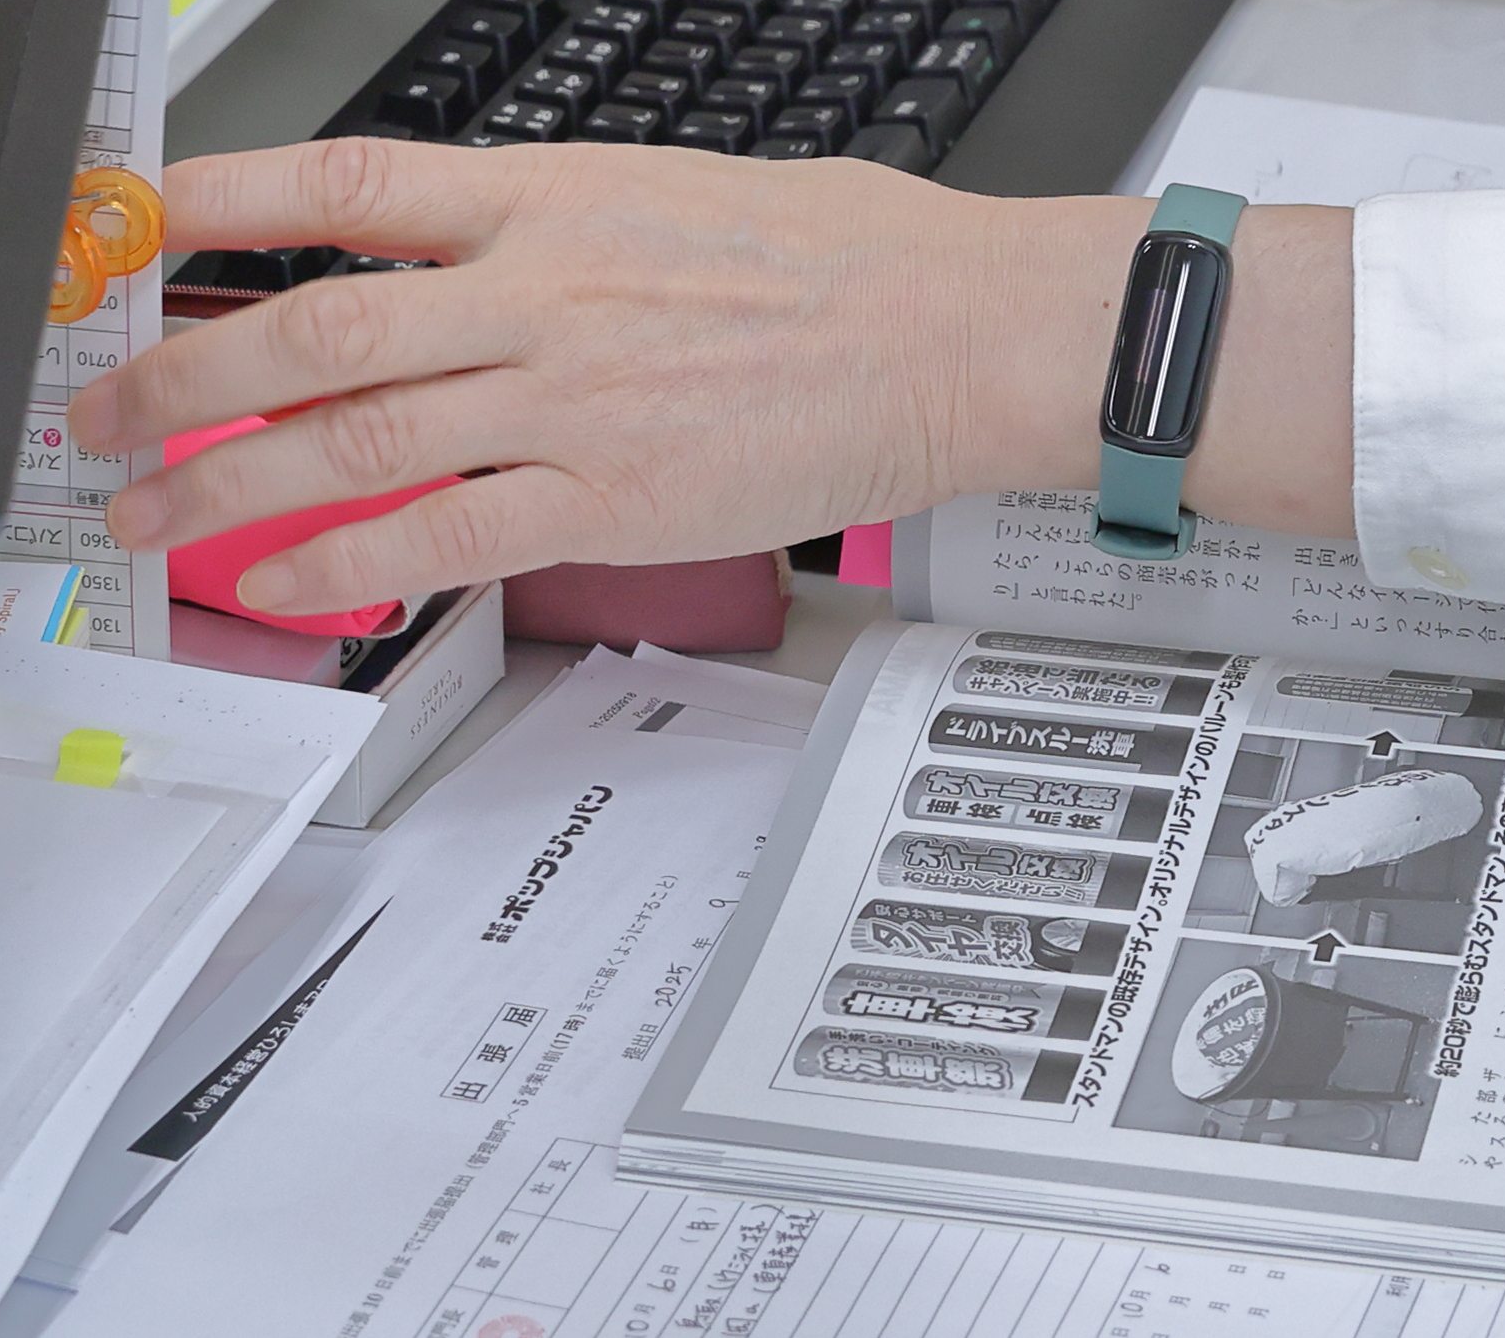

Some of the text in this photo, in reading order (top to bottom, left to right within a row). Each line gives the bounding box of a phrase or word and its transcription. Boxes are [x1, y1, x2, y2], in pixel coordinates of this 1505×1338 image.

[77, 351, 117, 369] 0710
[82, 574, 122, 591] 1350
[992, 552, 1261, 593] たら、こちらの商売あがった
[90, 618, 122, 633] 130
[420, 667, 457, 707] CARDS
[409, 677, 464, 741] BUSINESS
[943, 715, 1136, 759] ドライブスルー洗車
[925, 769, 1123, 811] オイル交換
[925, 797, 1007, 820] 車検
[499, 784, 615, 922] ポップジャパン
[903, 837, 1095, 883] オイル交換
[866, 919, 990, 965] タイヤ
[653, 963, 693, 1009] 2025
[839, 988, 1041, 1036] 車検
[622, 1022, 661, 1063] 提出日
